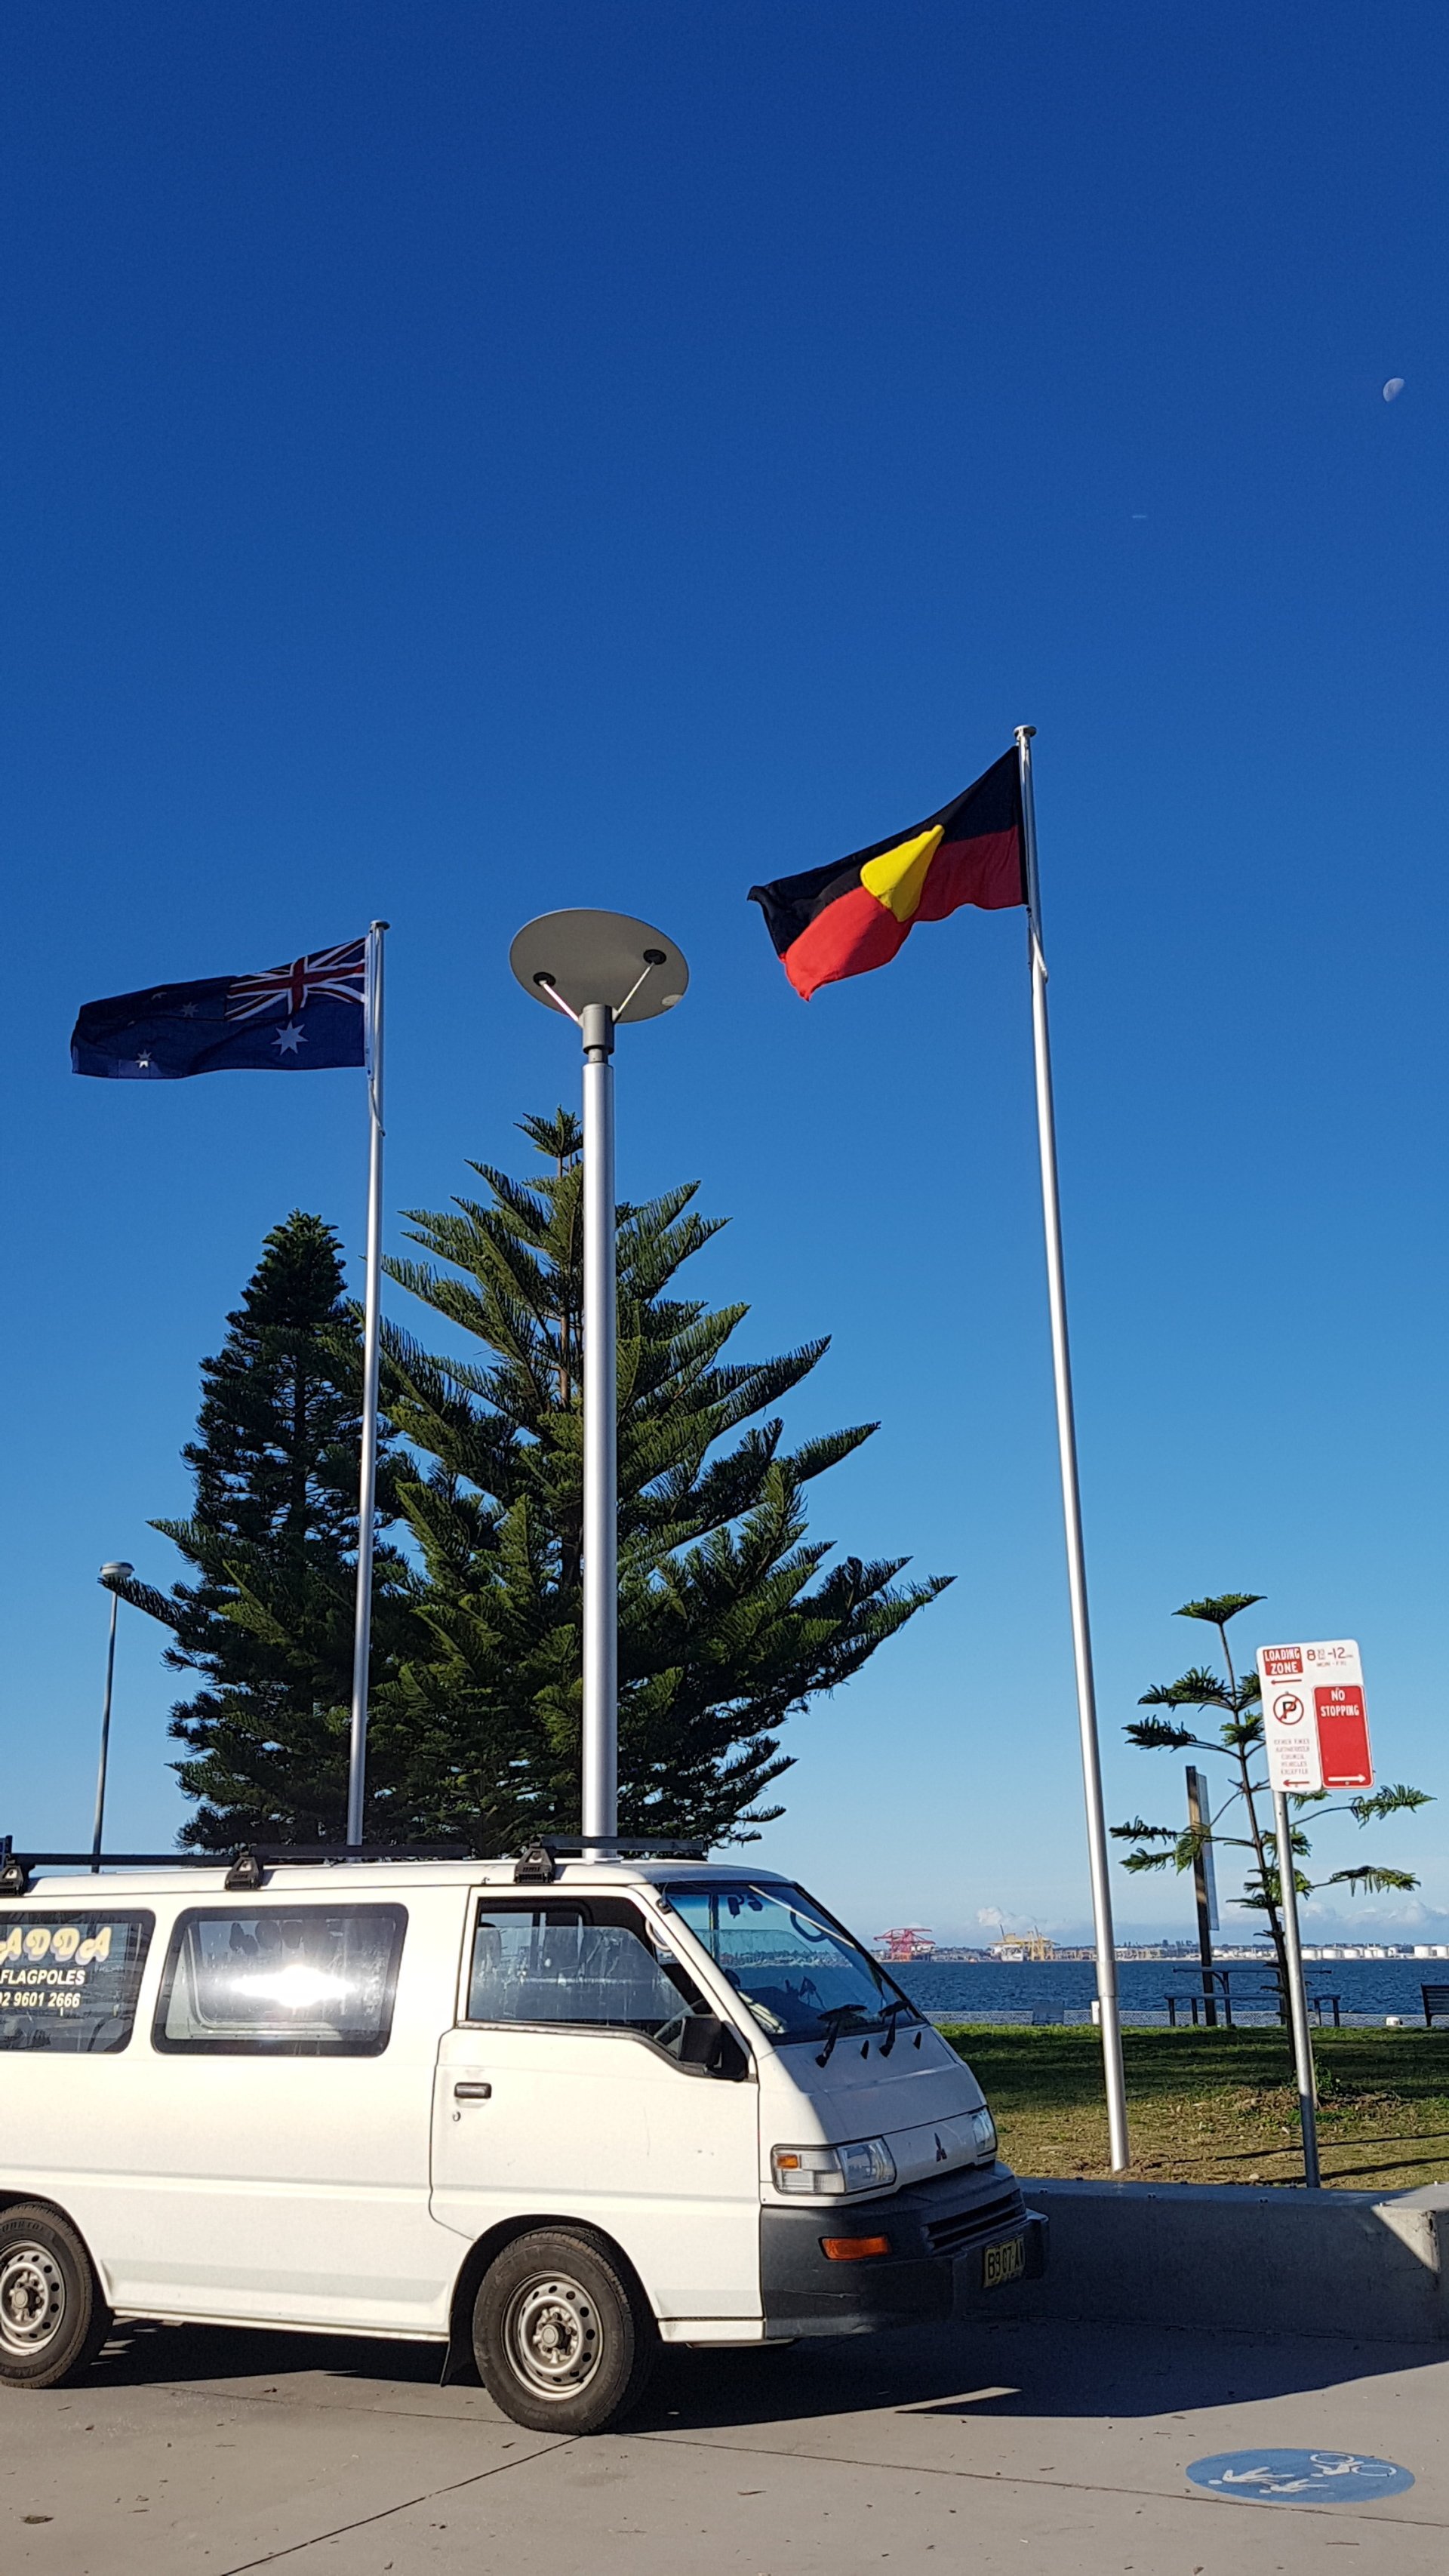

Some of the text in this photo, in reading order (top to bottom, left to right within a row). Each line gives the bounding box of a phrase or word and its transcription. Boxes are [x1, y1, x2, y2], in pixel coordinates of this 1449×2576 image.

[1264, 1648, 1300, 1661] LOADING
[1306, 1649, 1316, 1661] 8
[1270, 1661, 1299, 1675] ZONE
[1331, 1689, 1346, 1701] NO
[1321, 1704, 1360, 1718] STOPPING
[0, 1969, 86, 1986] FLAGPOLES
[13, 1991, 45, 2008] 9601
[48, 1992, 82, 2008] 2666
